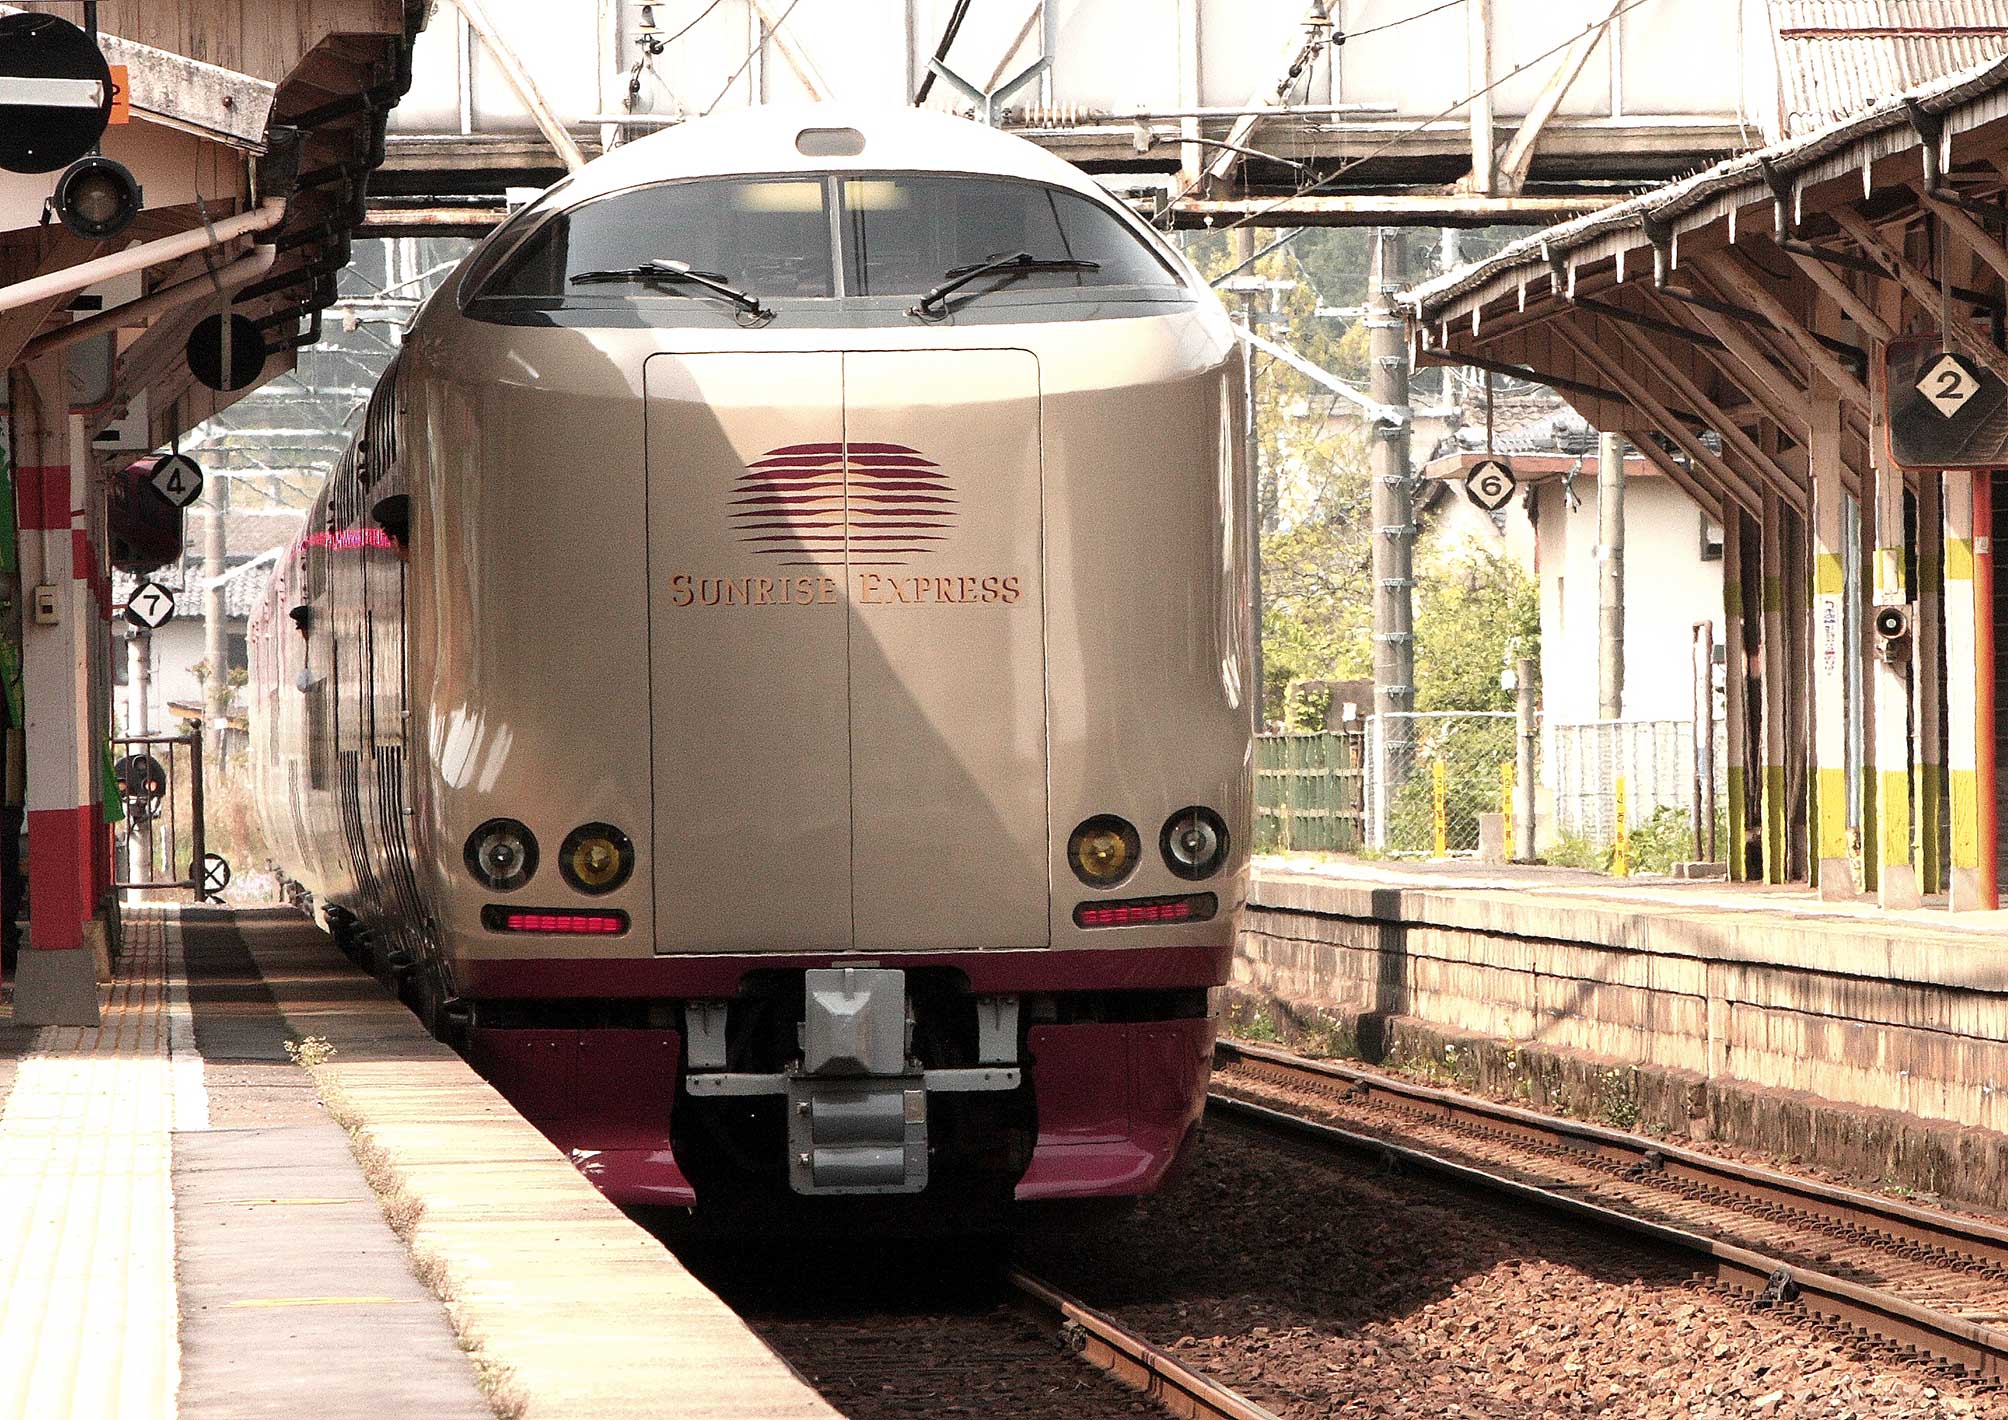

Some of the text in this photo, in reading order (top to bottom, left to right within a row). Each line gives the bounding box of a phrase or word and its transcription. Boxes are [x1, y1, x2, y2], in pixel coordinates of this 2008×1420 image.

[1935, 370, 1964, 399] 2
[166, 467, 186, 495] 4
[1480, 475, 1502, 496] 6
[671, 572, 1024, 608] SUNRISE EXPRESS
[142, 594, 161, 616] 7
